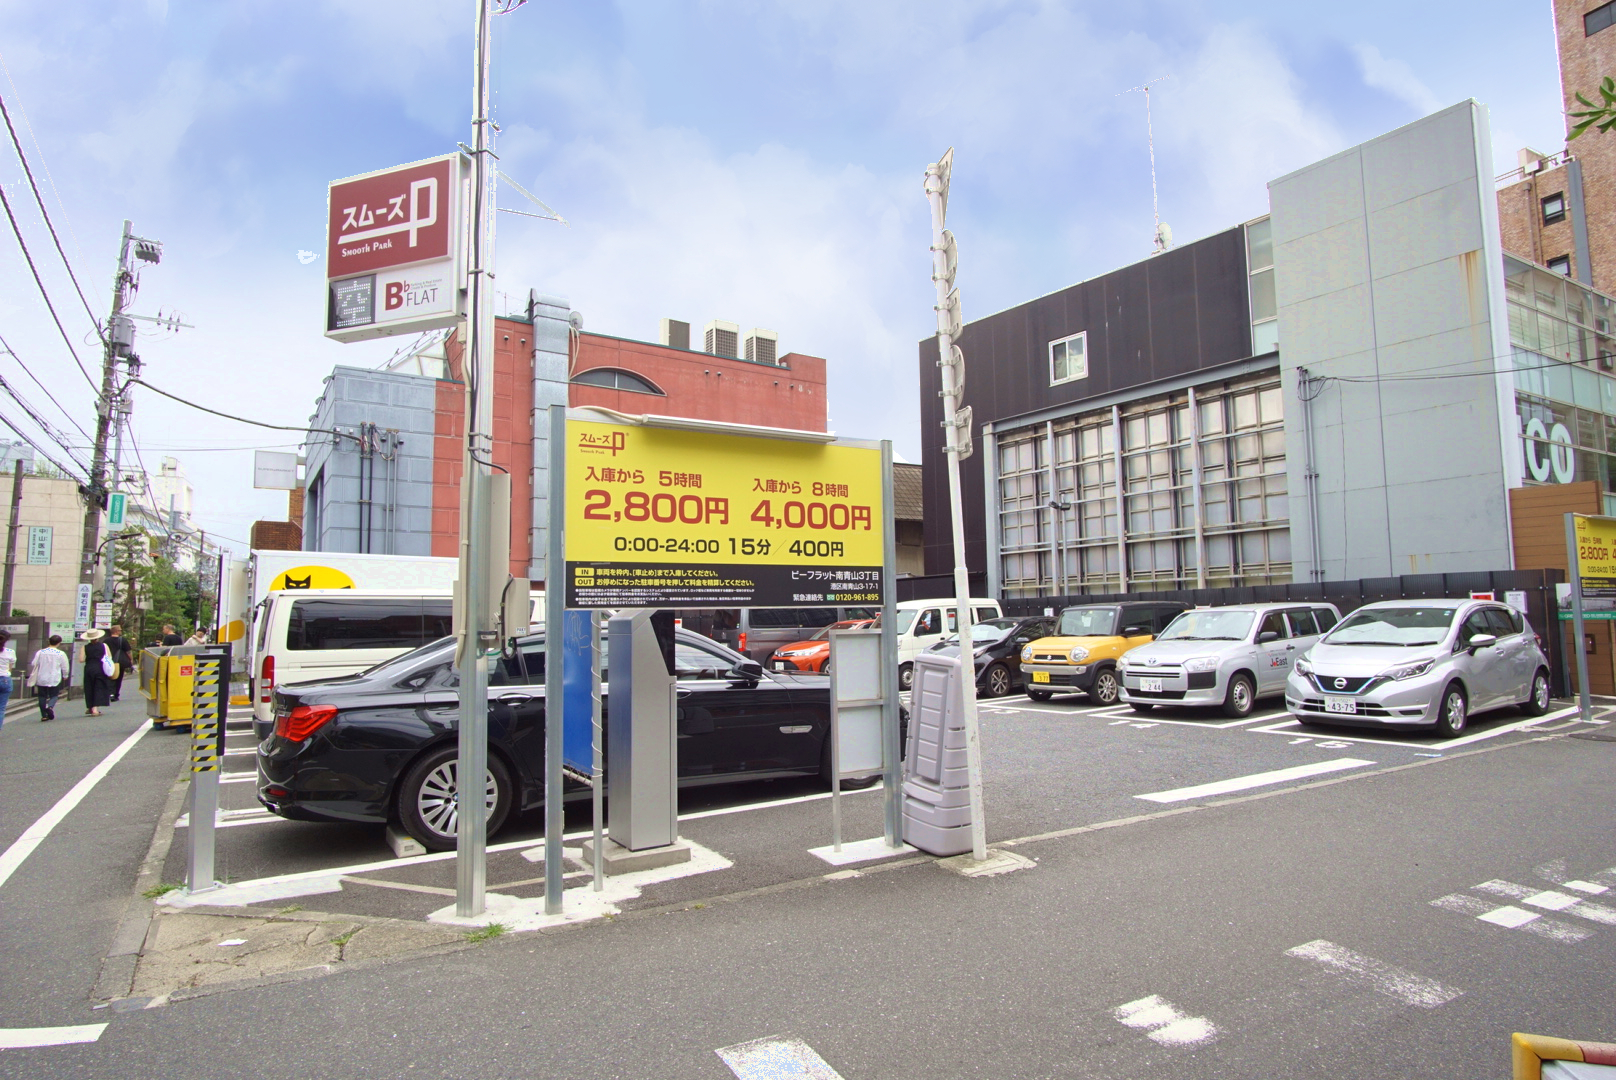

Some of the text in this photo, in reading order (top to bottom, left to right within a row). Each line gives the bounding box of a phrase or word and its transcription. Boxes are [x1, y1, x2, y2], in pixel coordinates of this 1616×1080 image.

[342, 194, 406, 231] スムーズ
[580, 433, 611, 444] スムーズ
[585, 466, 702, 488] 入庫から 5時間
[752, 478, 848, 498] 入庫から 8時間
[584, 489, 729, 525] 2,800円
[751, 500, 872, 531] 4,000円
[614, 537, 719, 553] 0:00-24:00
[1580, 546, 1609, 560] 2,800円
[1332, 703, 1355, 712] 43-75
